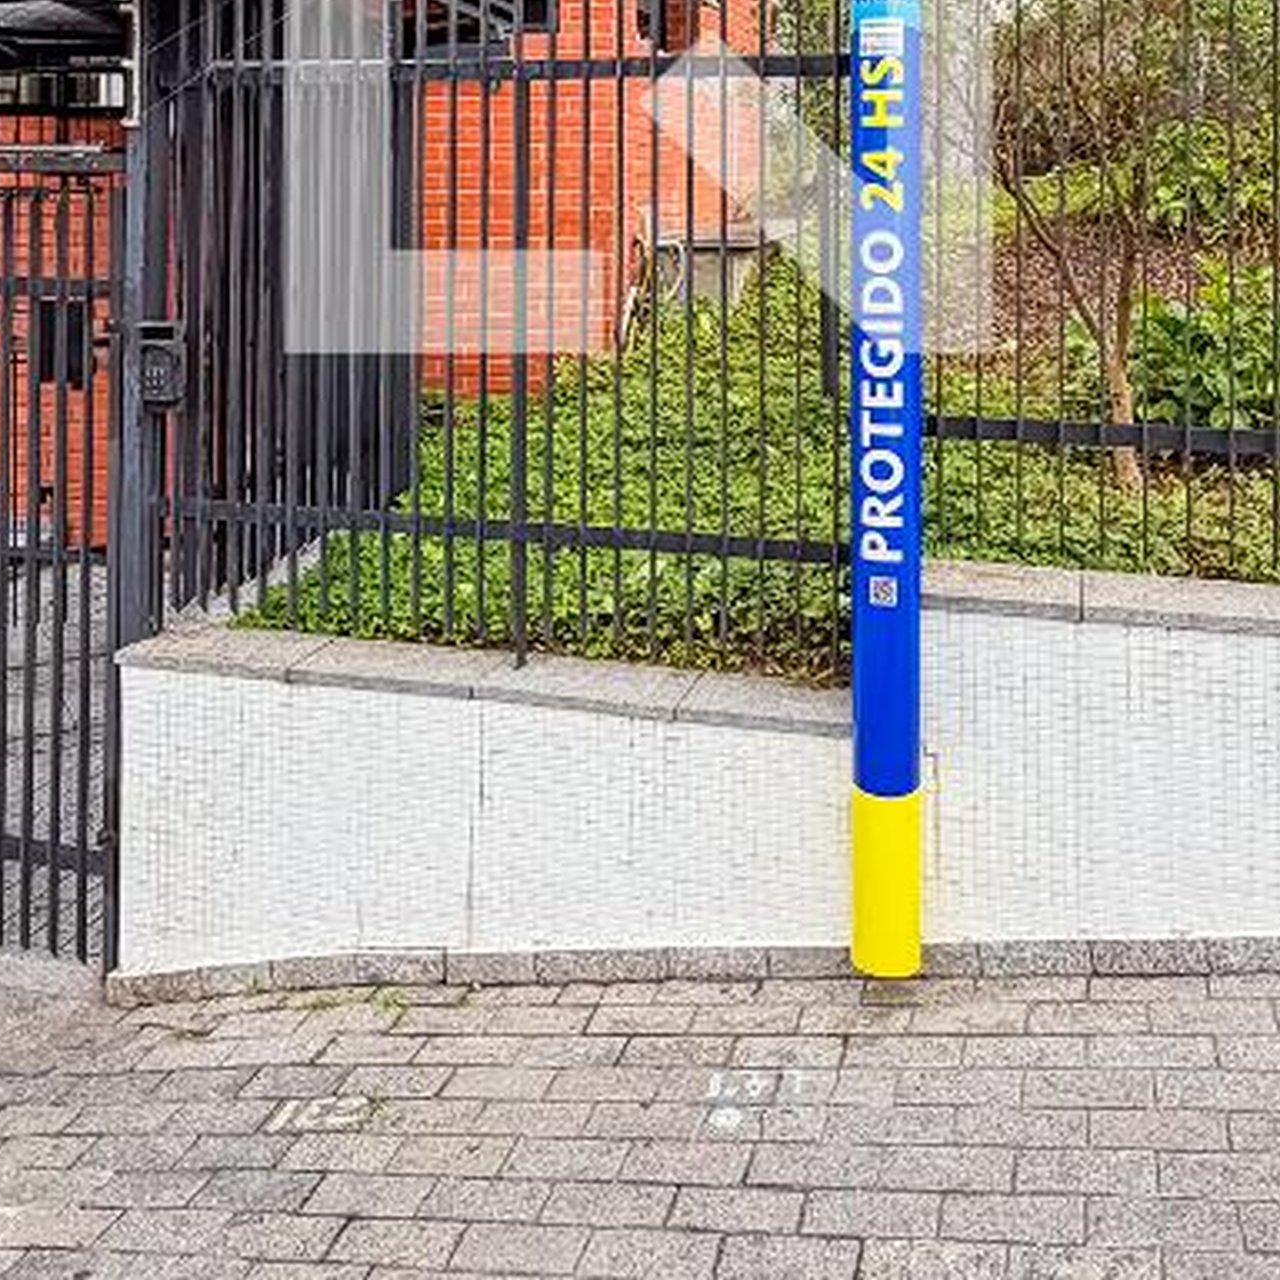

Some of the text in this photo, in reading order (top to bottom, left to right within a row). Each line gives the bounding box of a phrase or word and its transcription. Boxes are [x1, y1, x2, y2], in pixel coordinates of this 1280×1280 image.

[859, 55, 904, 128] HS
[860, 145, 904, 213] 24
[859, 229, 904, 562] PROTEGIDO
